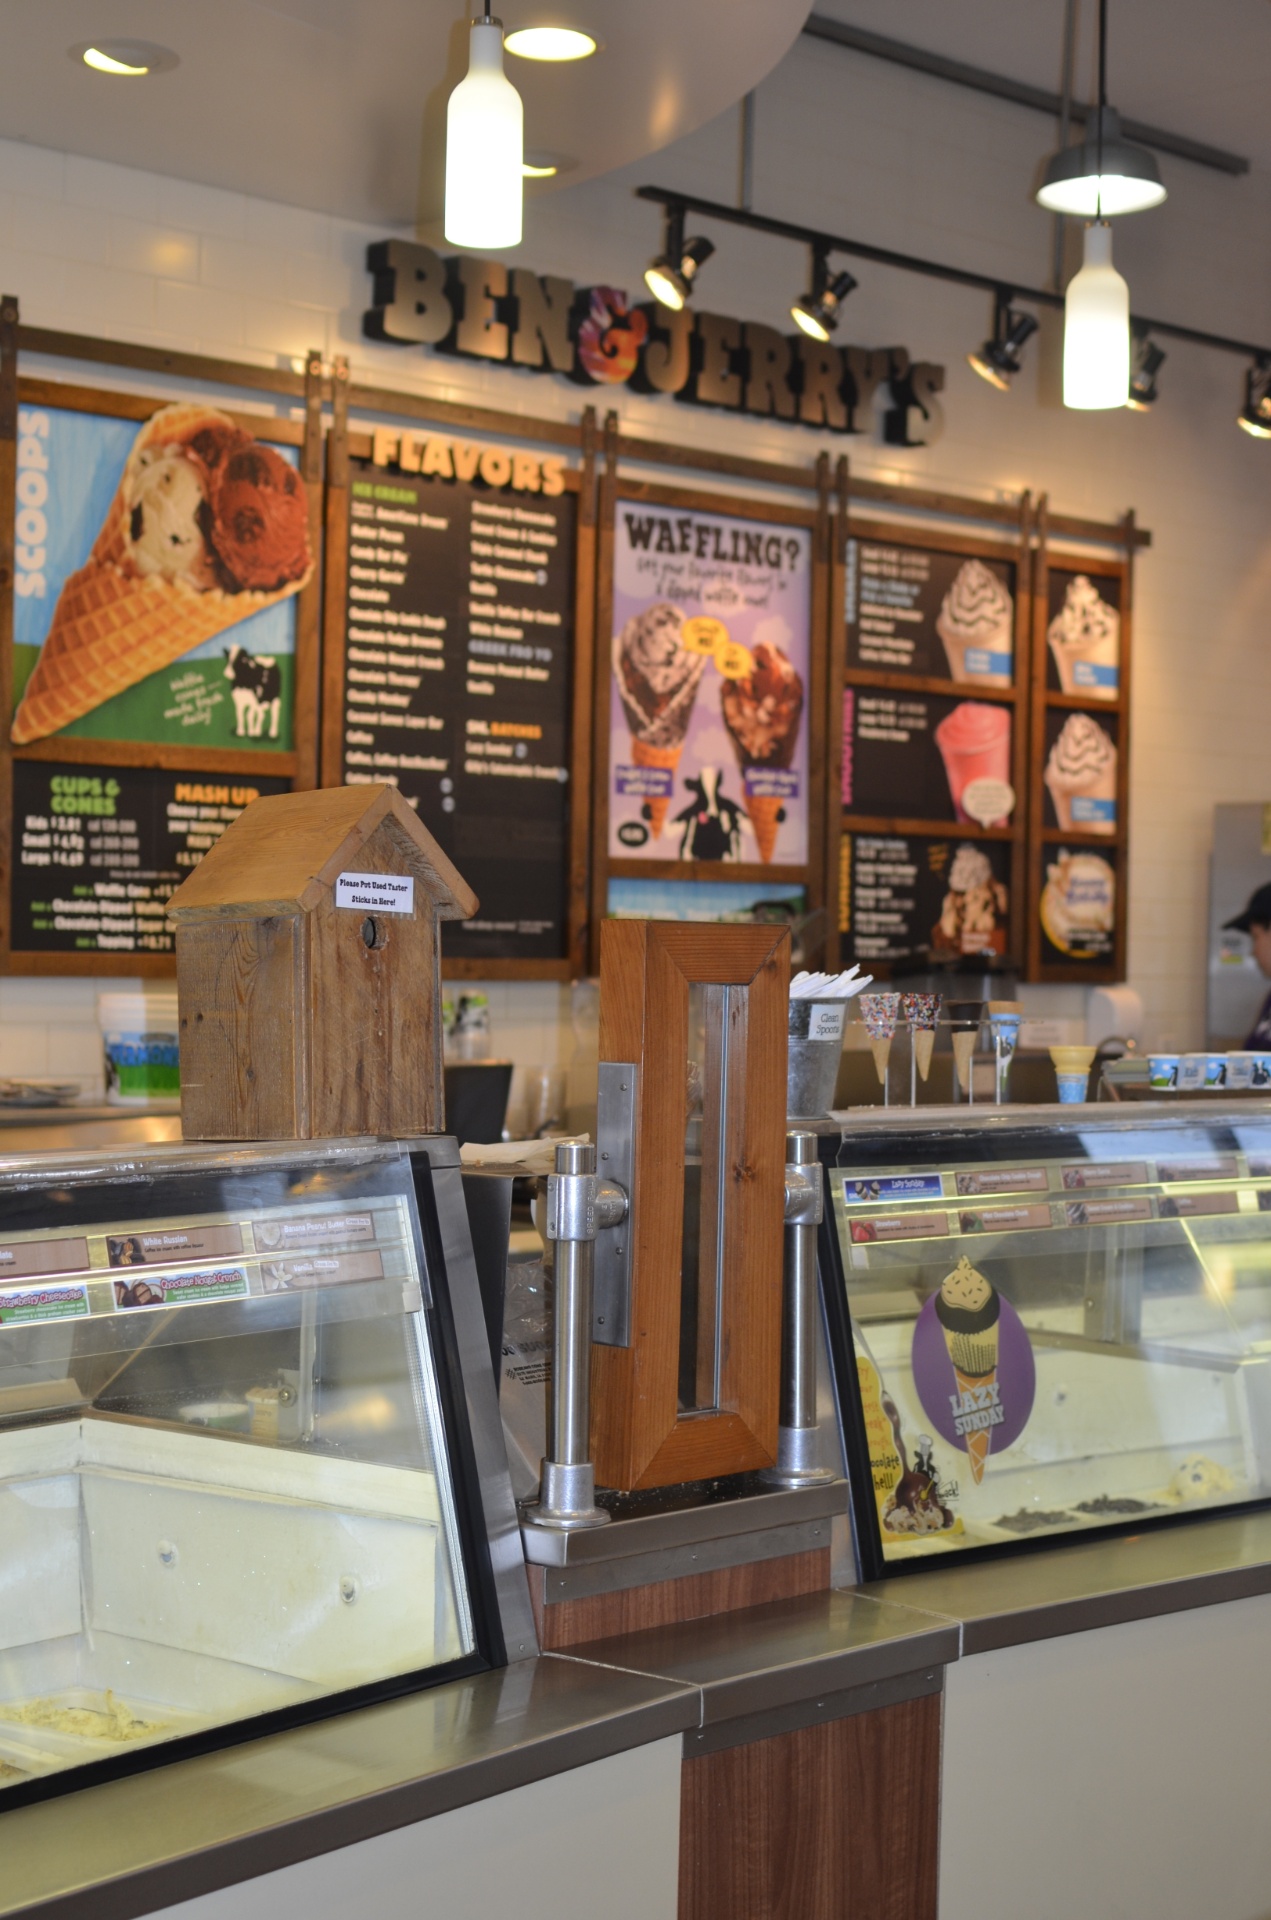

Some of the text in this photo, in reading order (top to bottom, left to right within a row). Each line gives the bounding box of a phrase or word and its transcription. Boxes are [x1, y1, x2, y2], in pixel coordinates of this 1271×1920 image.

[366, 239, 574, 373] BEN
[644, 302, 946, 448] JERRY'S
[373, 428, 565, 496] FLAVORS
[14, 411, 50, 598] SCOOPS
[624, 512, 800, 572] WAFFLING?
[50, 775, 102, 797] CUPS
[175, 783, 229, 804] MASH
[50, 796, 117, 816] CONES
[340, 879, 360, 888] Please
[372, 882, 387, 890] Used
[388, 883, 408, 892] Taster
[352, 895, 396, 906] Sticks in Here!
[821, 1013, 839, 1023] Clean
[816, 1025, 840, 1036] Spoons
[284, 1220, 345, 1233] Banana Peanut Butter
[143, 1235, 188, 1247] White Russian
[293, 1263, 313, 1272] Vanilla
[161, 1270, 242, 1290] Chocolate Nougat Crunch
[40, 1289, 83, 1304] Cheesecake
[949, 1382, 1001, 1418] LAZY
[955, 1405, 1005, 1437] SUNDAY
[871, 1453, 900, 1470] ocolate
[873, 1473, 894, 1490] hell!
